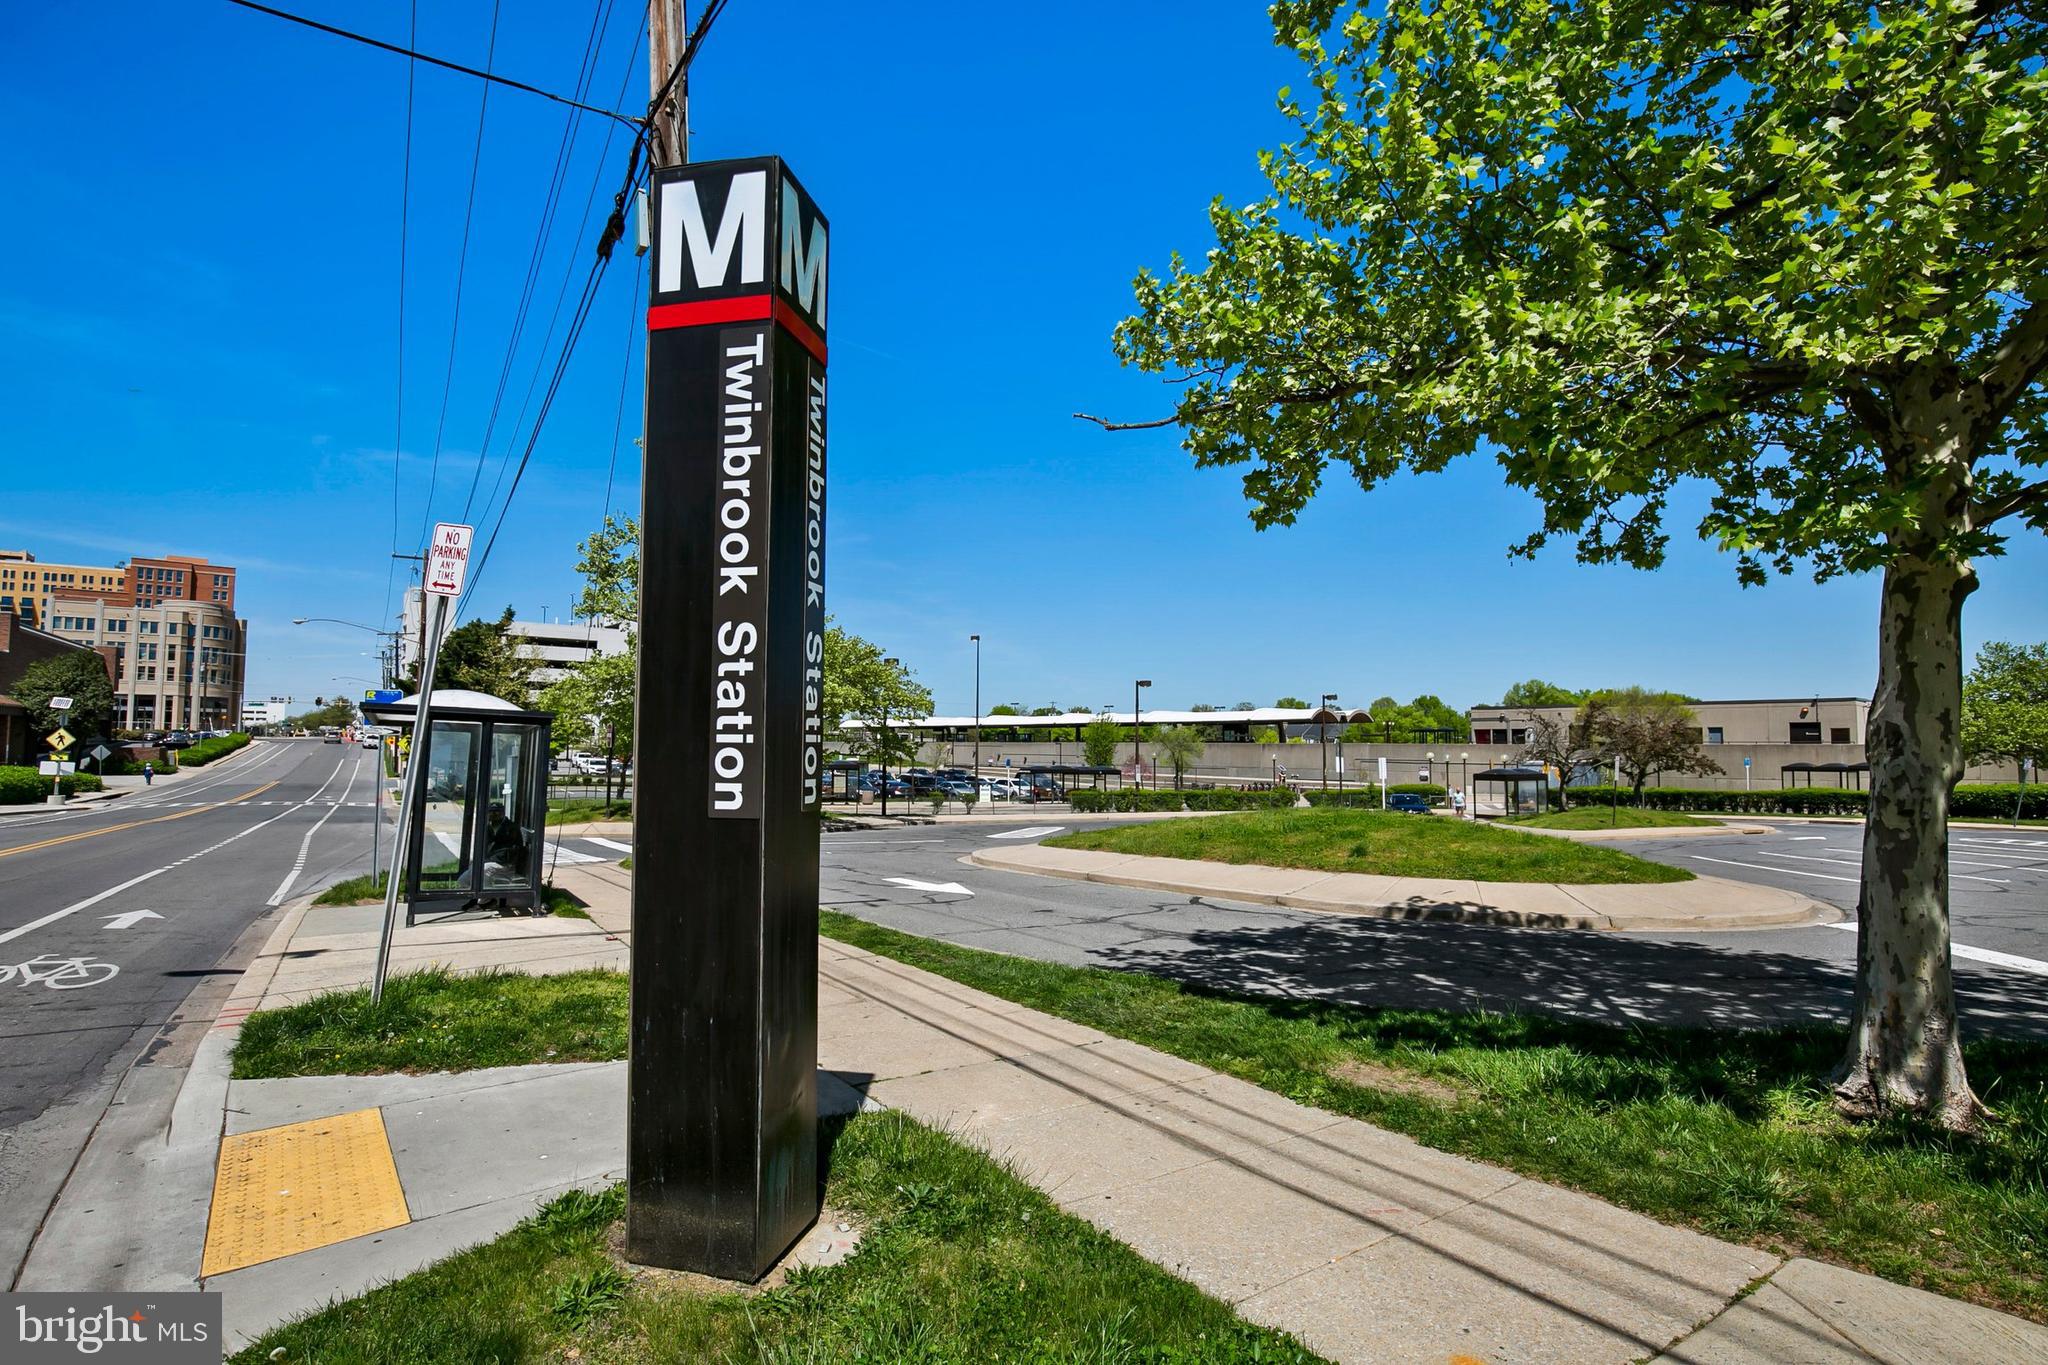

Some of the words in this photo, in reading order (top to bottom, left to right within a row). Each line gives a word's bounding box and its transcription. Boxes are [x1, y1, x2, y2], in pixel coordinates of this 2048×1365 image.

[659, 170, 766, 293] M
[781, 175, 826, 331] M
[719, 332, 764, 596] Twinbrook
[807, 376, 826, 609] Twinbrook
[433, 545, 467, 560] PARKING
[437, 571, 455, 580] TIME
[440, 561, 456, 570] ANY
[445, 532, 460, 545] NO
[714, 621, 758, 811] Station
[804, 630, 823, 806] Station
